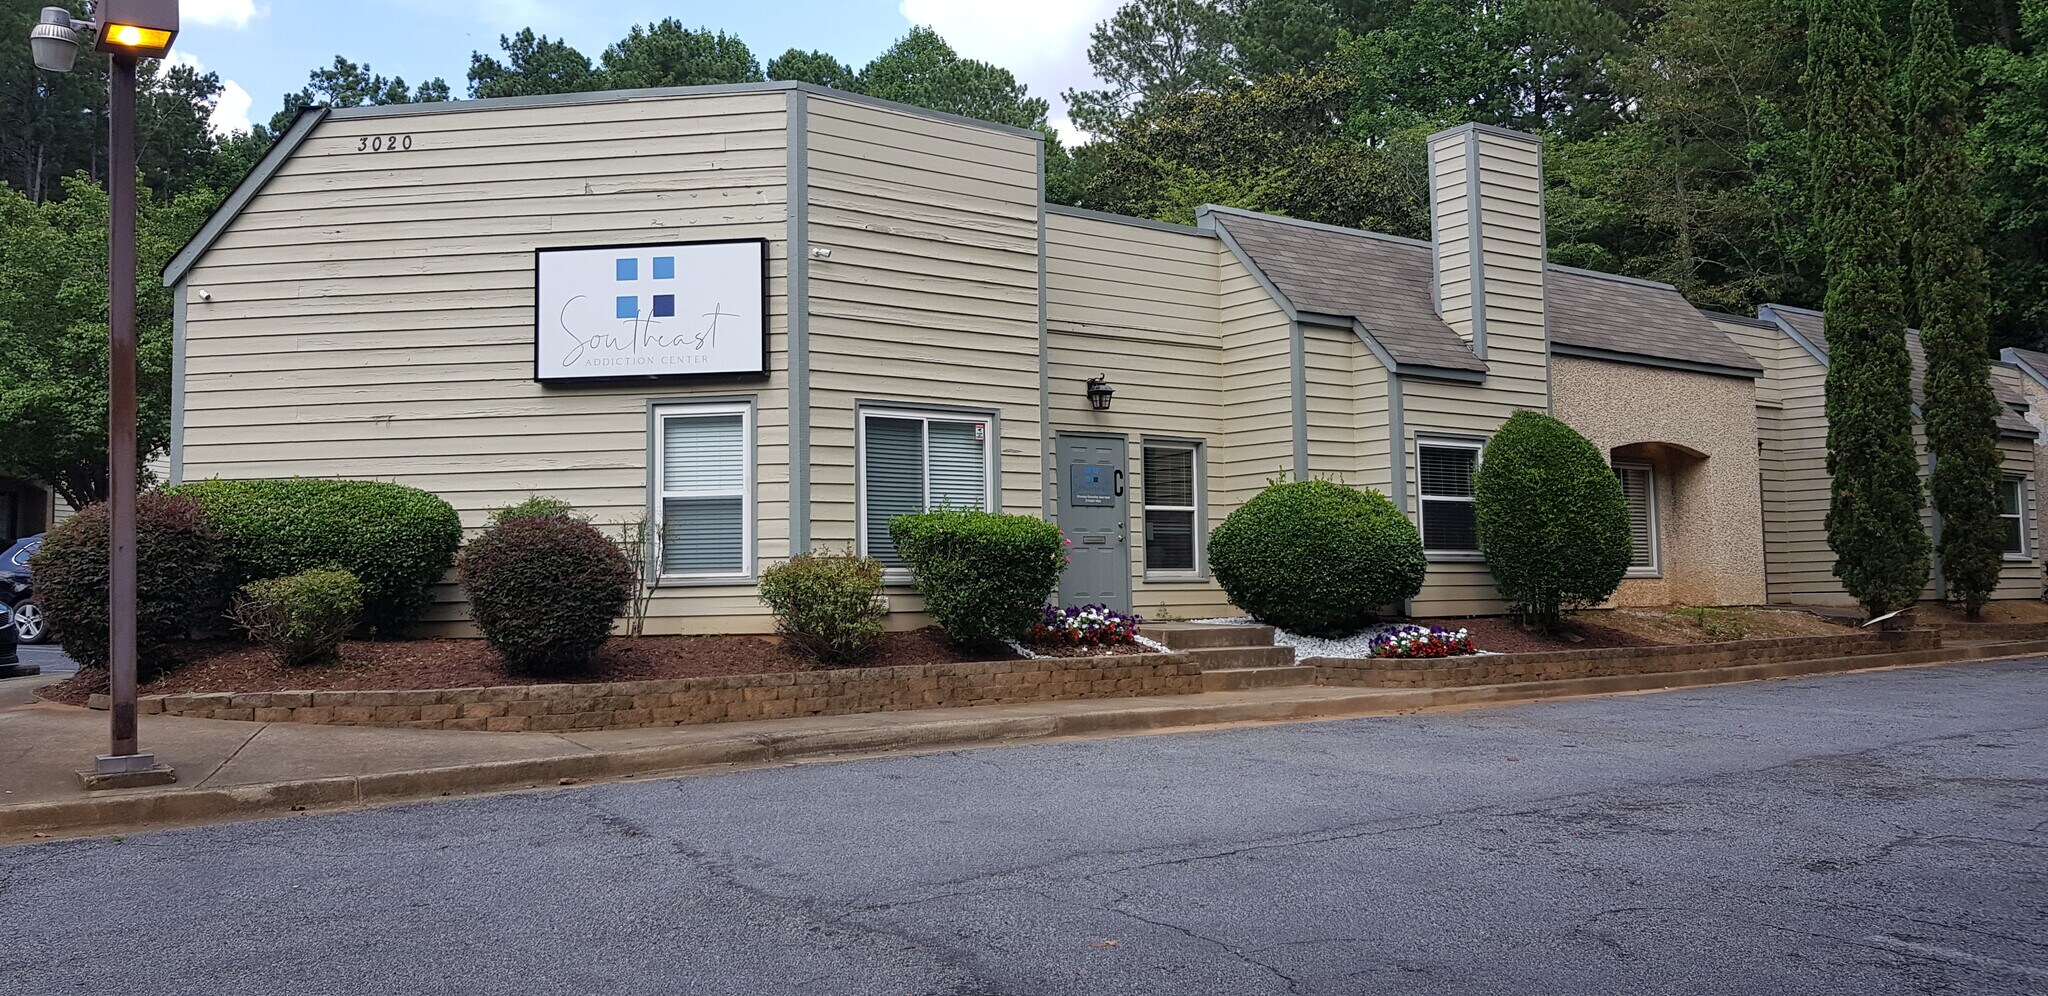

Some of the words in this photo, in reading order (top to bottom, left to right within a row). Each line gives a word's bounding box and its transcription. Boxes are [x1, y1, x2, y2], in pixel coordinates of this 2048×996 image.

[357, 135, 412, 152] 3020
[560, 294, 741, 368] Southeast
[585, 356, 654, 367] ADDICTION
[661, 354, 709, 365] CENTER
[1113, 469, 1124, 497] C
